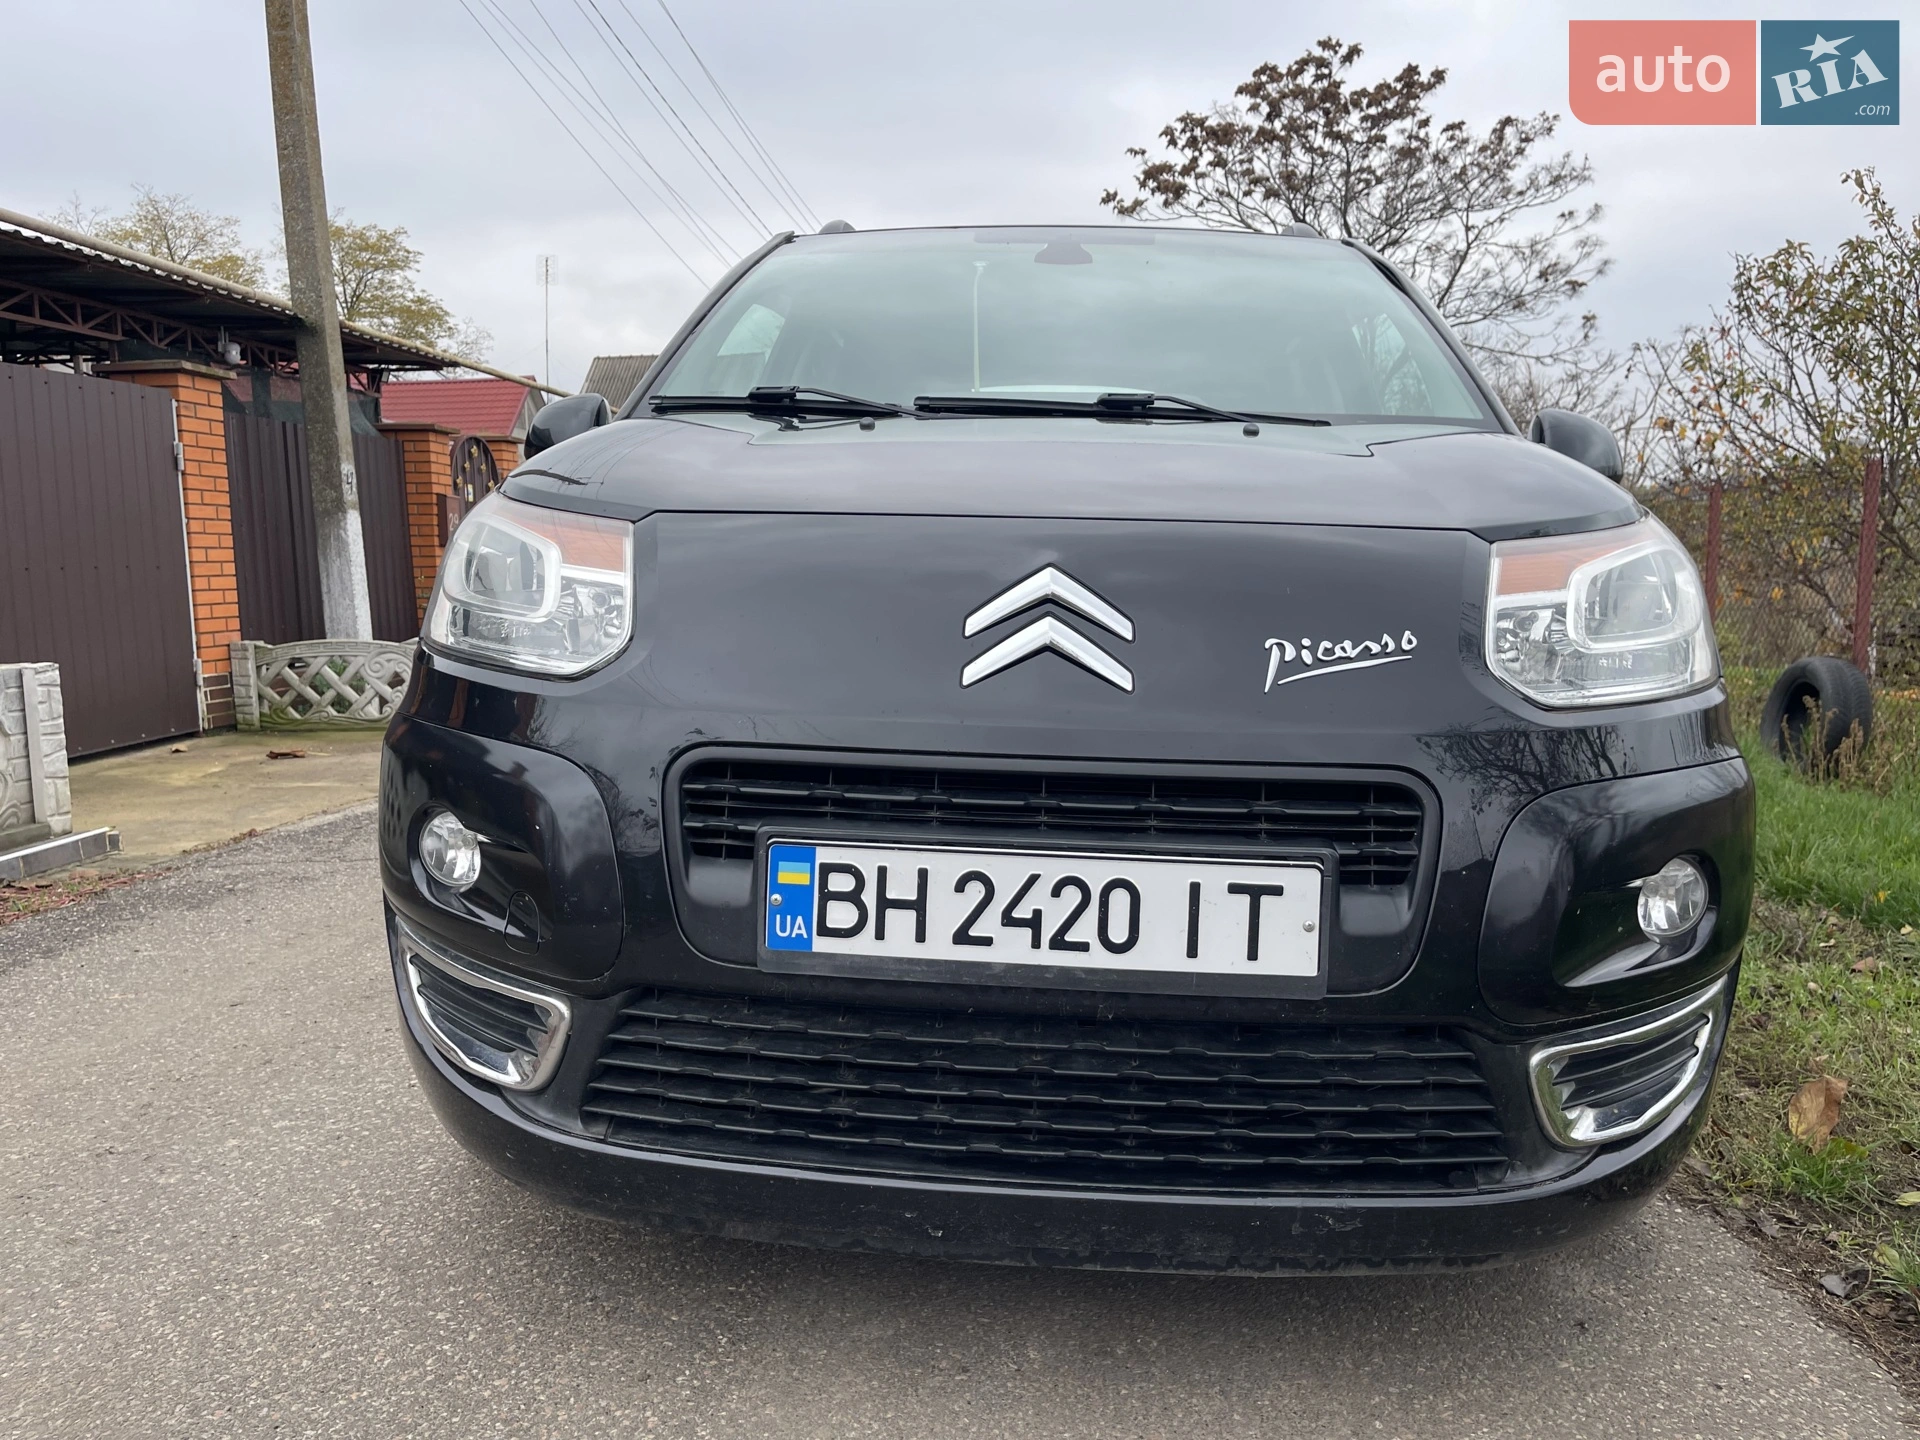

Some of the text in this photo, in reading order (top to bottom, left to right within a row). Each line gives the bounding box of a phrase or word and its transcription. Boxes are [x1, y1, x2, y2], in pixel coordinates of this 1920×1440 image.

[775, 914, 809, 939] UA
[815, 861, 930, 943] BH
[951, 869, 1142, 955] 2420
